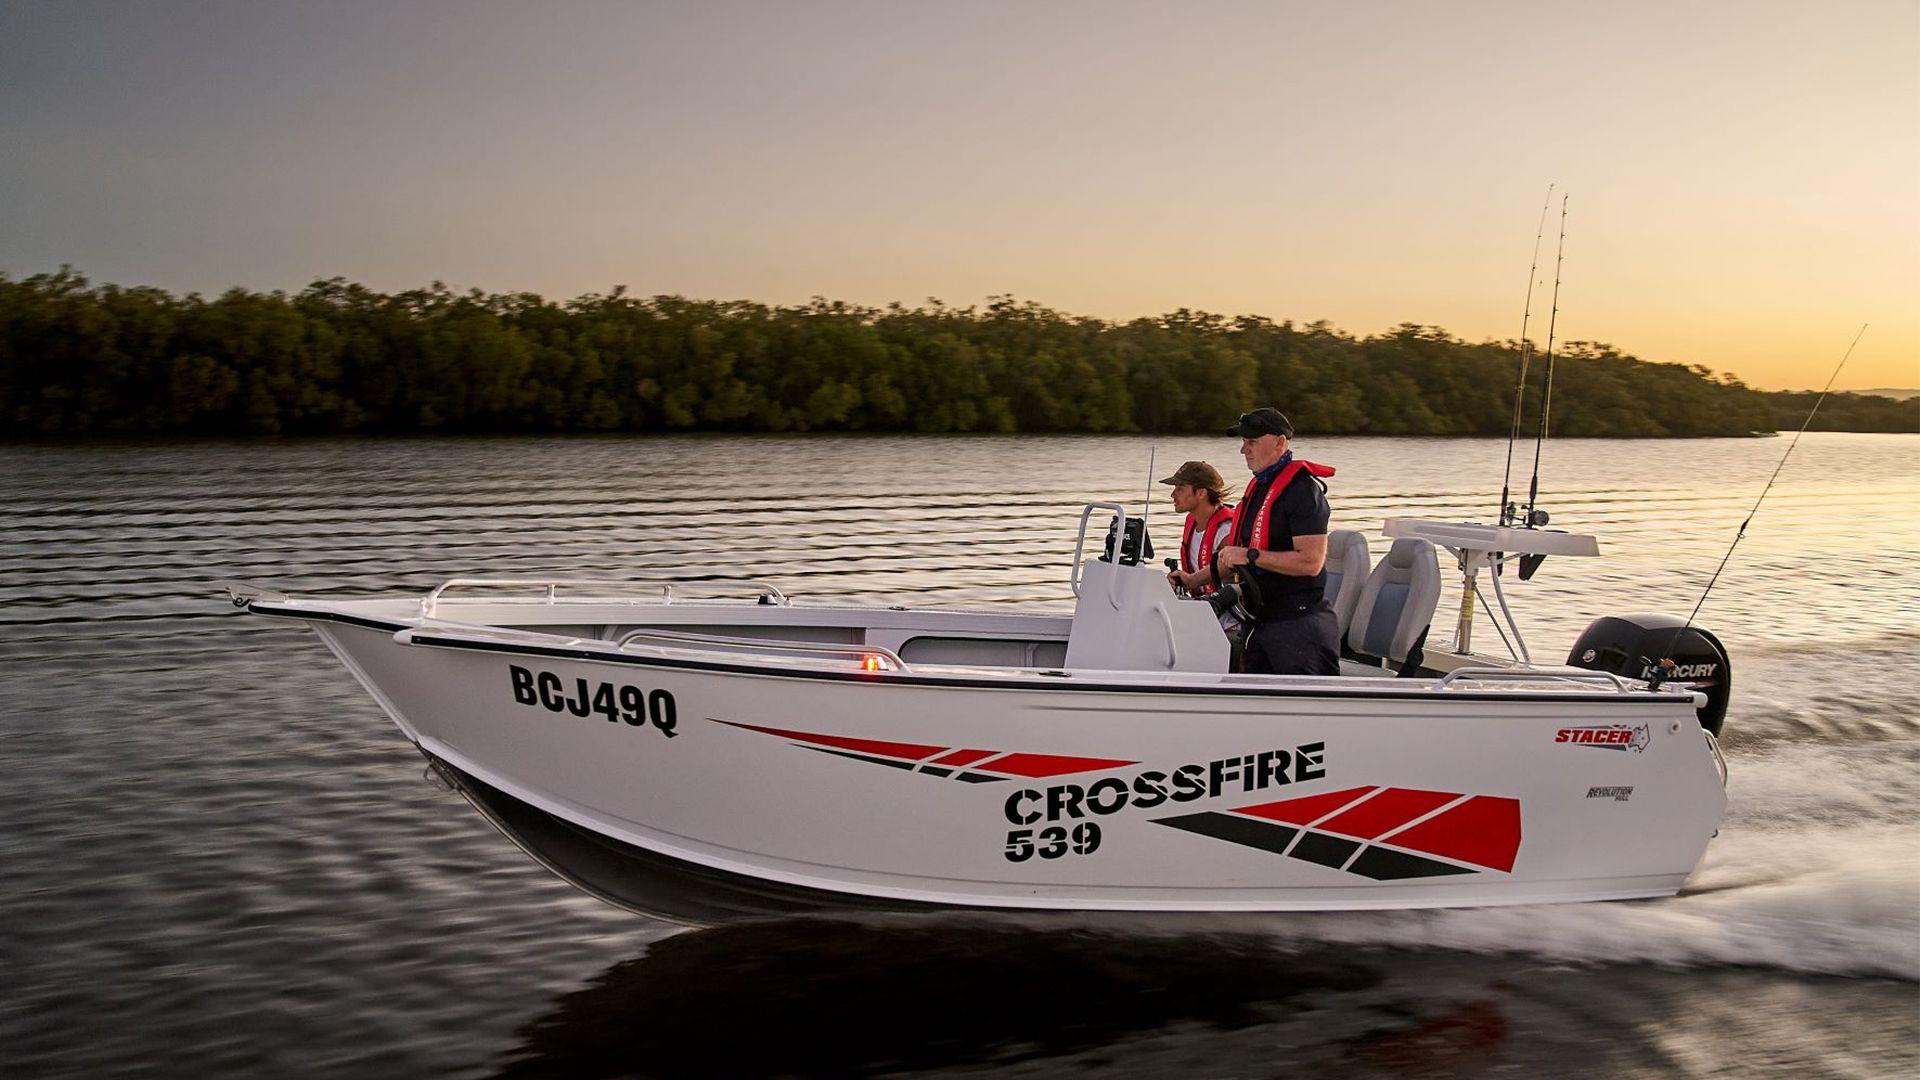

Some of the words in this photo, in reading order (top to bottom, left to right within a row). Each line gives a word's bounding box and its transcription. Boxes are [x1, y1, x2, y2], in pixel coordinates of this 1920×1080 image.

[1641, 664, 1717, 678] MRCURY
[509, 664, 678, 738] BCJ49Q
[1555, 729, 1633, 744] STACER
[1004, 741, 1326, 826] CROSSFIRE
[1004, 822, 1102, 862] 539
